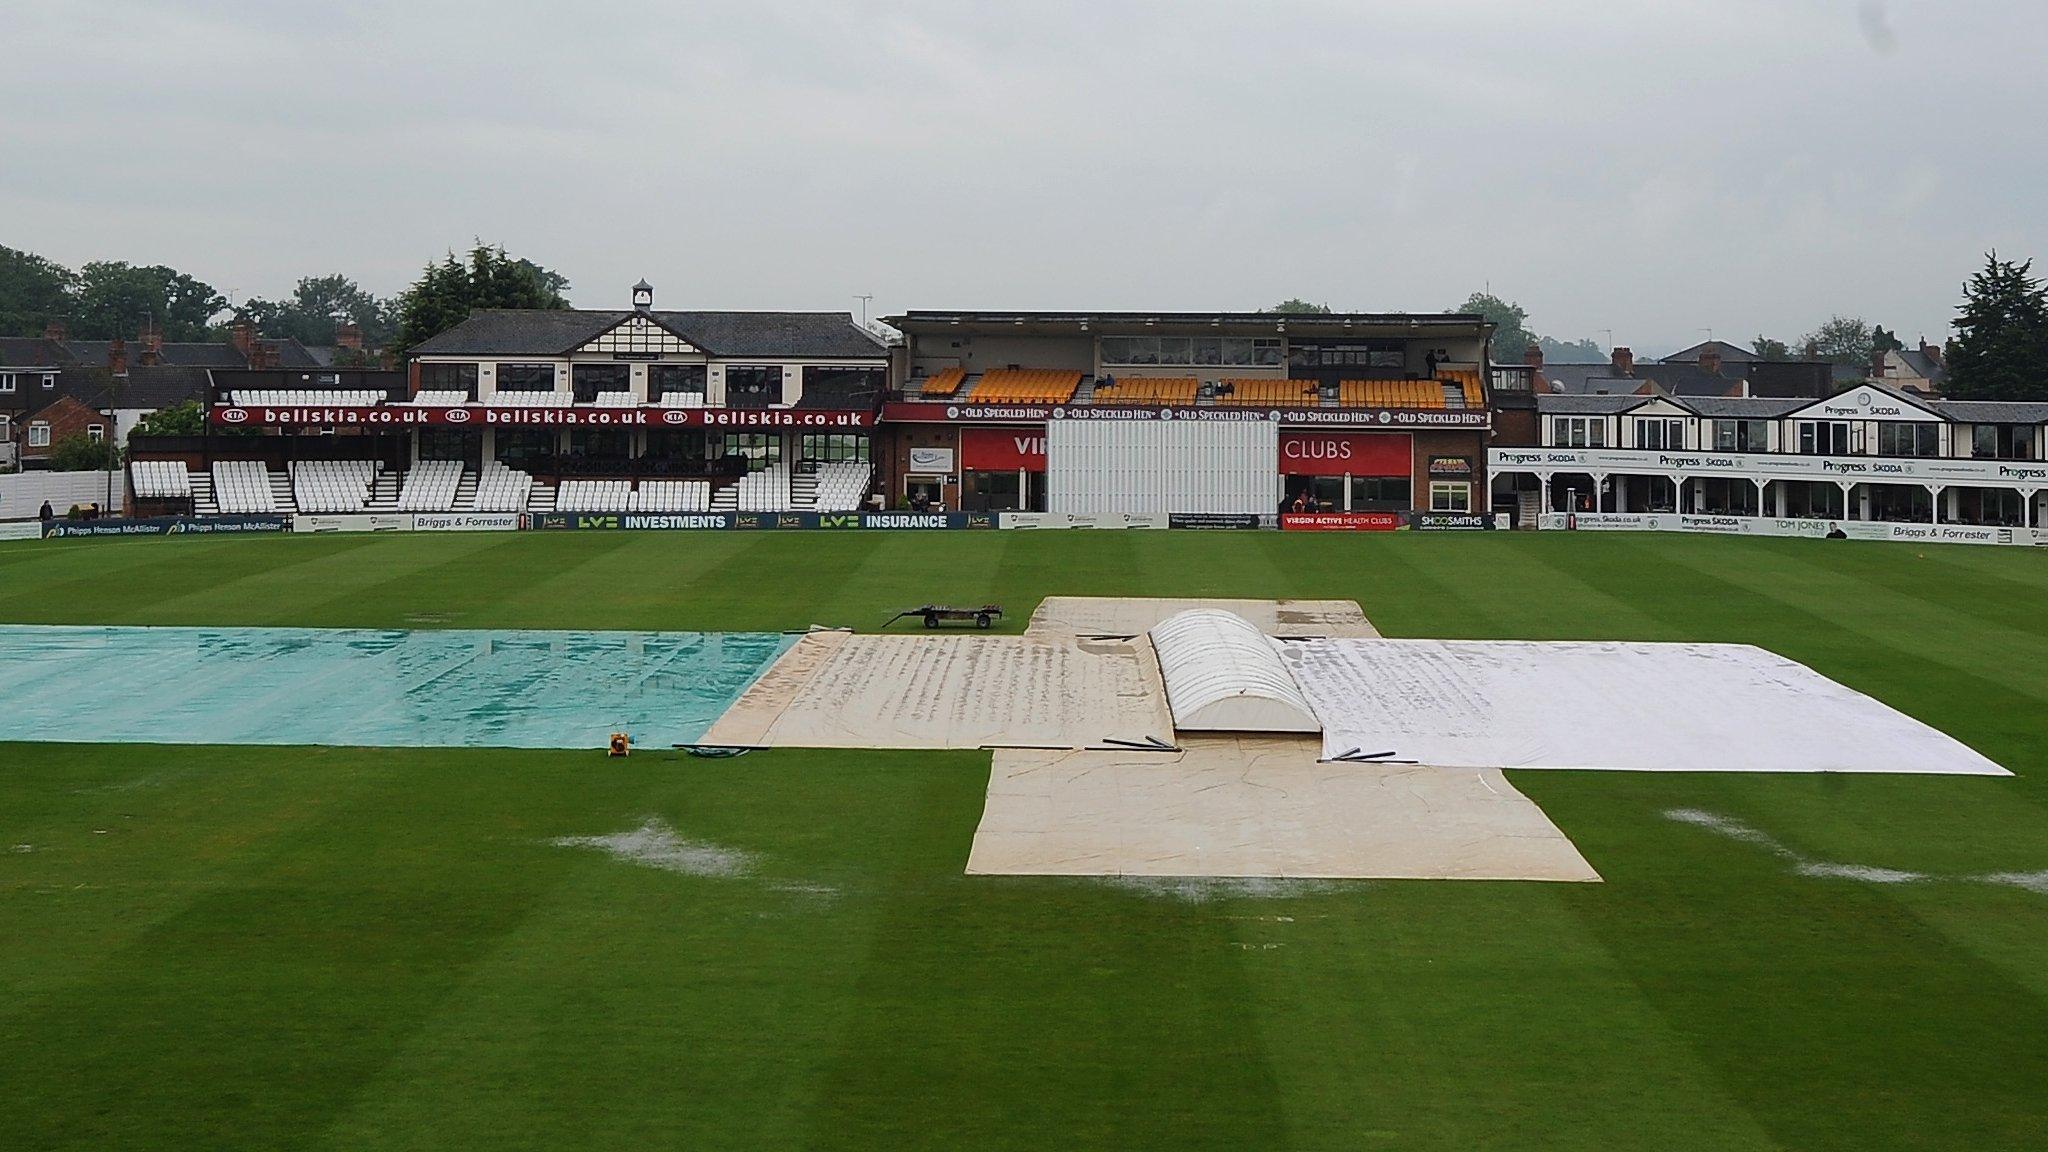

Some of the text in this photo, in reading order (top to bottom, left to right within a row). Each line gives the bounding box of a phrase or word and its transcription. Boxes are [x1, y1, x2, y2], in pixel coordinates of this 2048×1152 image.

[225, 410, 245, 421] KIA
[264, 408, 429, 423] bellskia.co.uk
[448, 411, 467, 421] KIA
[965, 408, 982, 418] OLD
[983, 408, 1025, 418] SPECKLED
[1071, 409, 1090, 419] OLD
[1090, 409, 1133, 419] SPECKLED
[1179, 410, 1197, 420] OLD
[1198, 410, 1241, 420] SPECKLED
[1824, 405, 1859, 416] Progress
[486, 409, 647, 424] bellskia.co.uk
[666, 412, 684, 422] KIA
[703, 411, 862, 425] bellskia.co.uk
[1287, 412, 1306, 422] OLD
[1307, 412, 1350, 422] SPECKLED
[1398, 412, 1416, 423] OLD
[1417, 412, 1461, 423] SPECKLED
[1285, 440, 1351, 459] CLUBS
[1499, 451, 1542, 464] Progress
[1659, 455, 1701, 467] Progress
[1823, 460, 1867, 474] Progress
[1999, 465, 2046, 480] Progress
[417, 517, 513, 528] Briggs & Forrester
[625, 515, 726, 528] INVESTMENTS
[866, 515, 948, 528] INSURANCE
[1315, 517, 1342, 525] ACTIVE
[1421, 516, 1483, 525] SHOOSMITHS
[1681, 516, 1711, 525] Progress
[1775, 520, 1825, 531] TOM JONES
[1893, 526, 1927, 538] Briggs
[1929, 527, 1938, 537] &
[1942, 528, 1991, 540] Forrester
